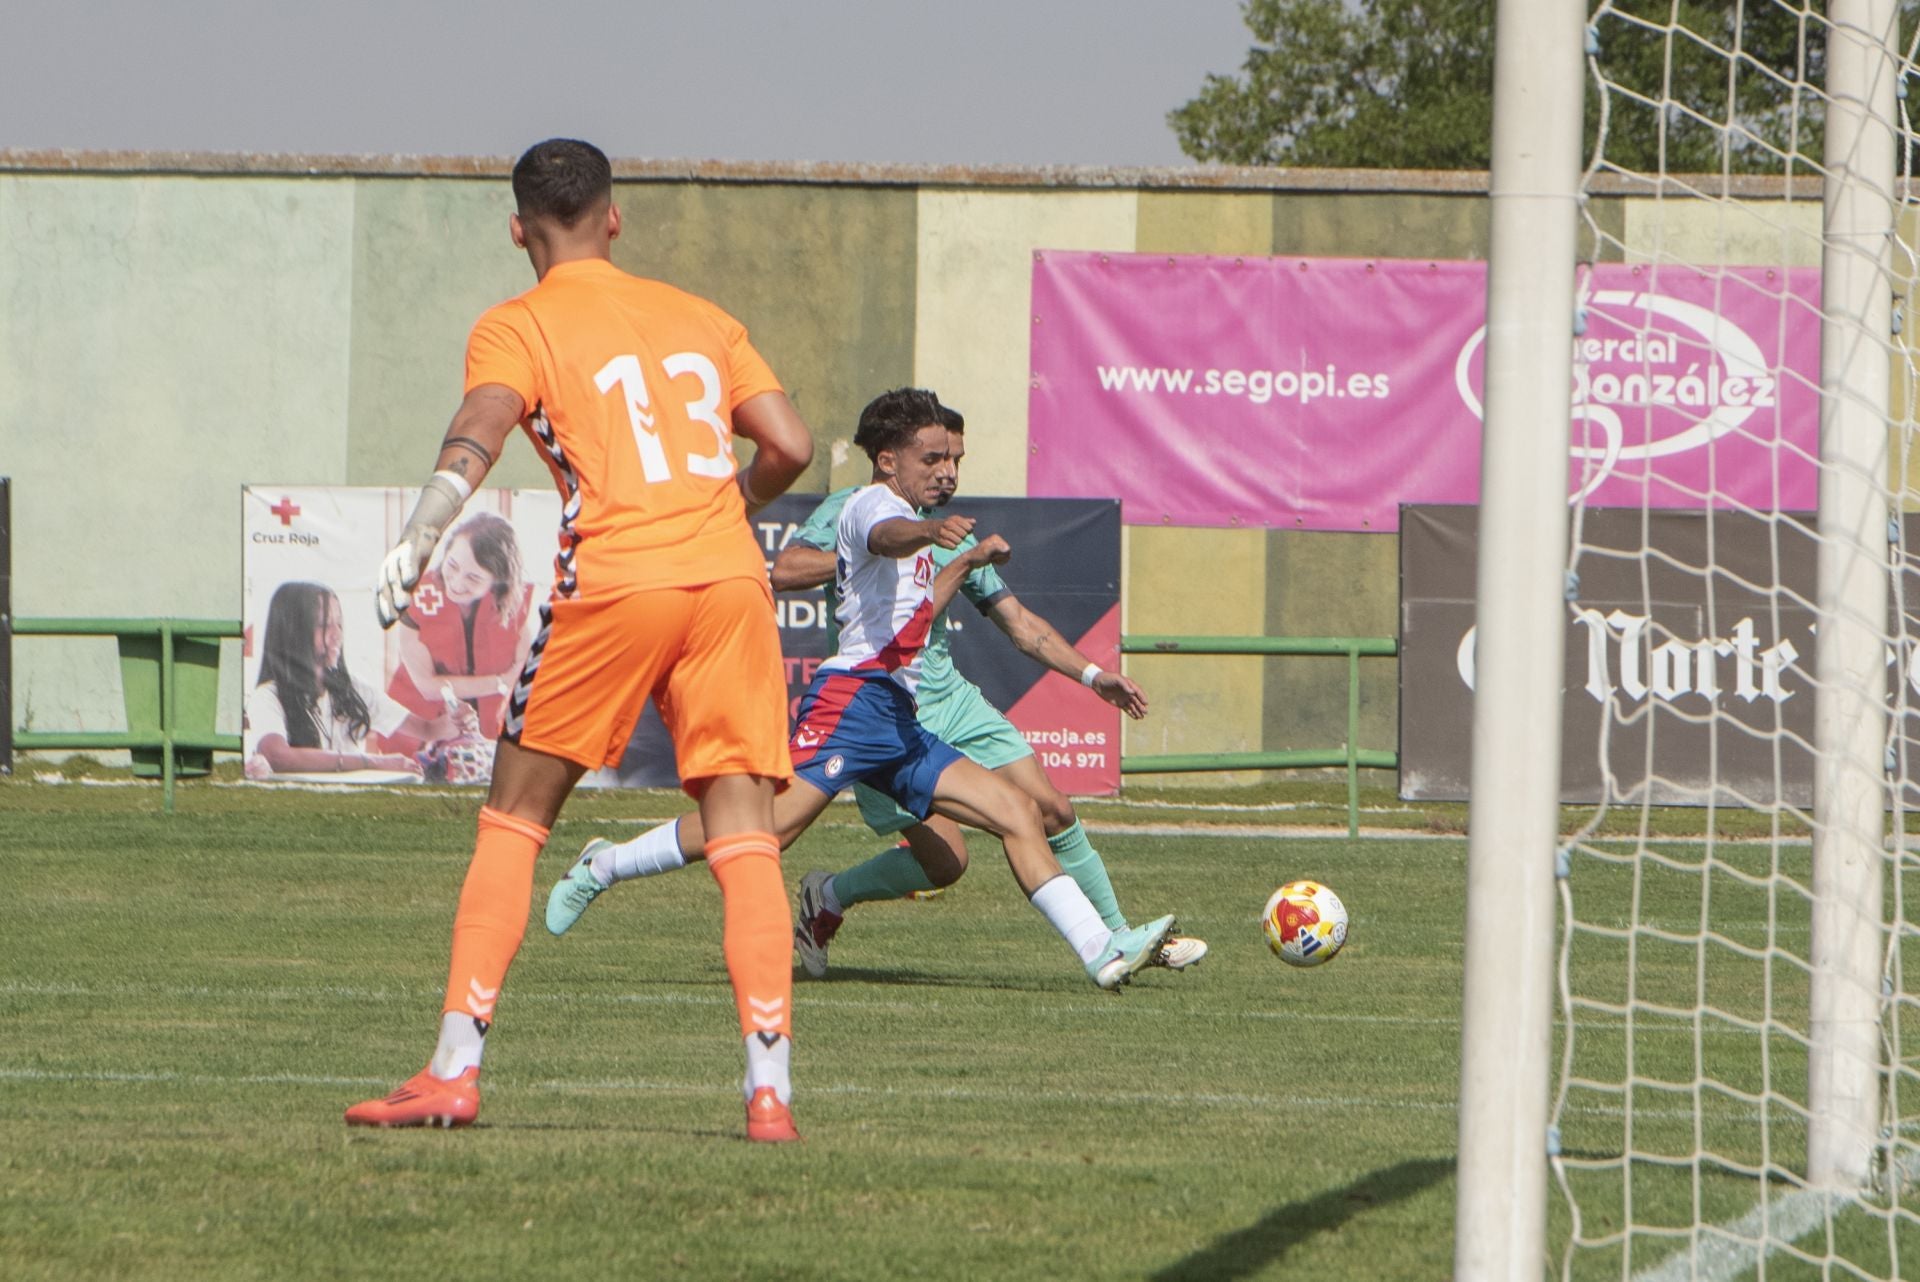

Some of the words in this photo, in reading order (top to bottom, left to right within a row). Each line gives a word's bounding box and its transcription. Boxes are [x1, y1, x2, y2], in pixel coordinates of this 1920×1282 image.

[1097, 364, 1390, 404] www.segopi.es
[593, 351, 734, 484] 13
[252, 531, 285, 544] Cruz
[289, 532, 319, 547] Roja
[1574, 608, 1799, 702] Norte
[1041, 752, 1071, 768] 104
[1076, 752, 1105, 768] 971
